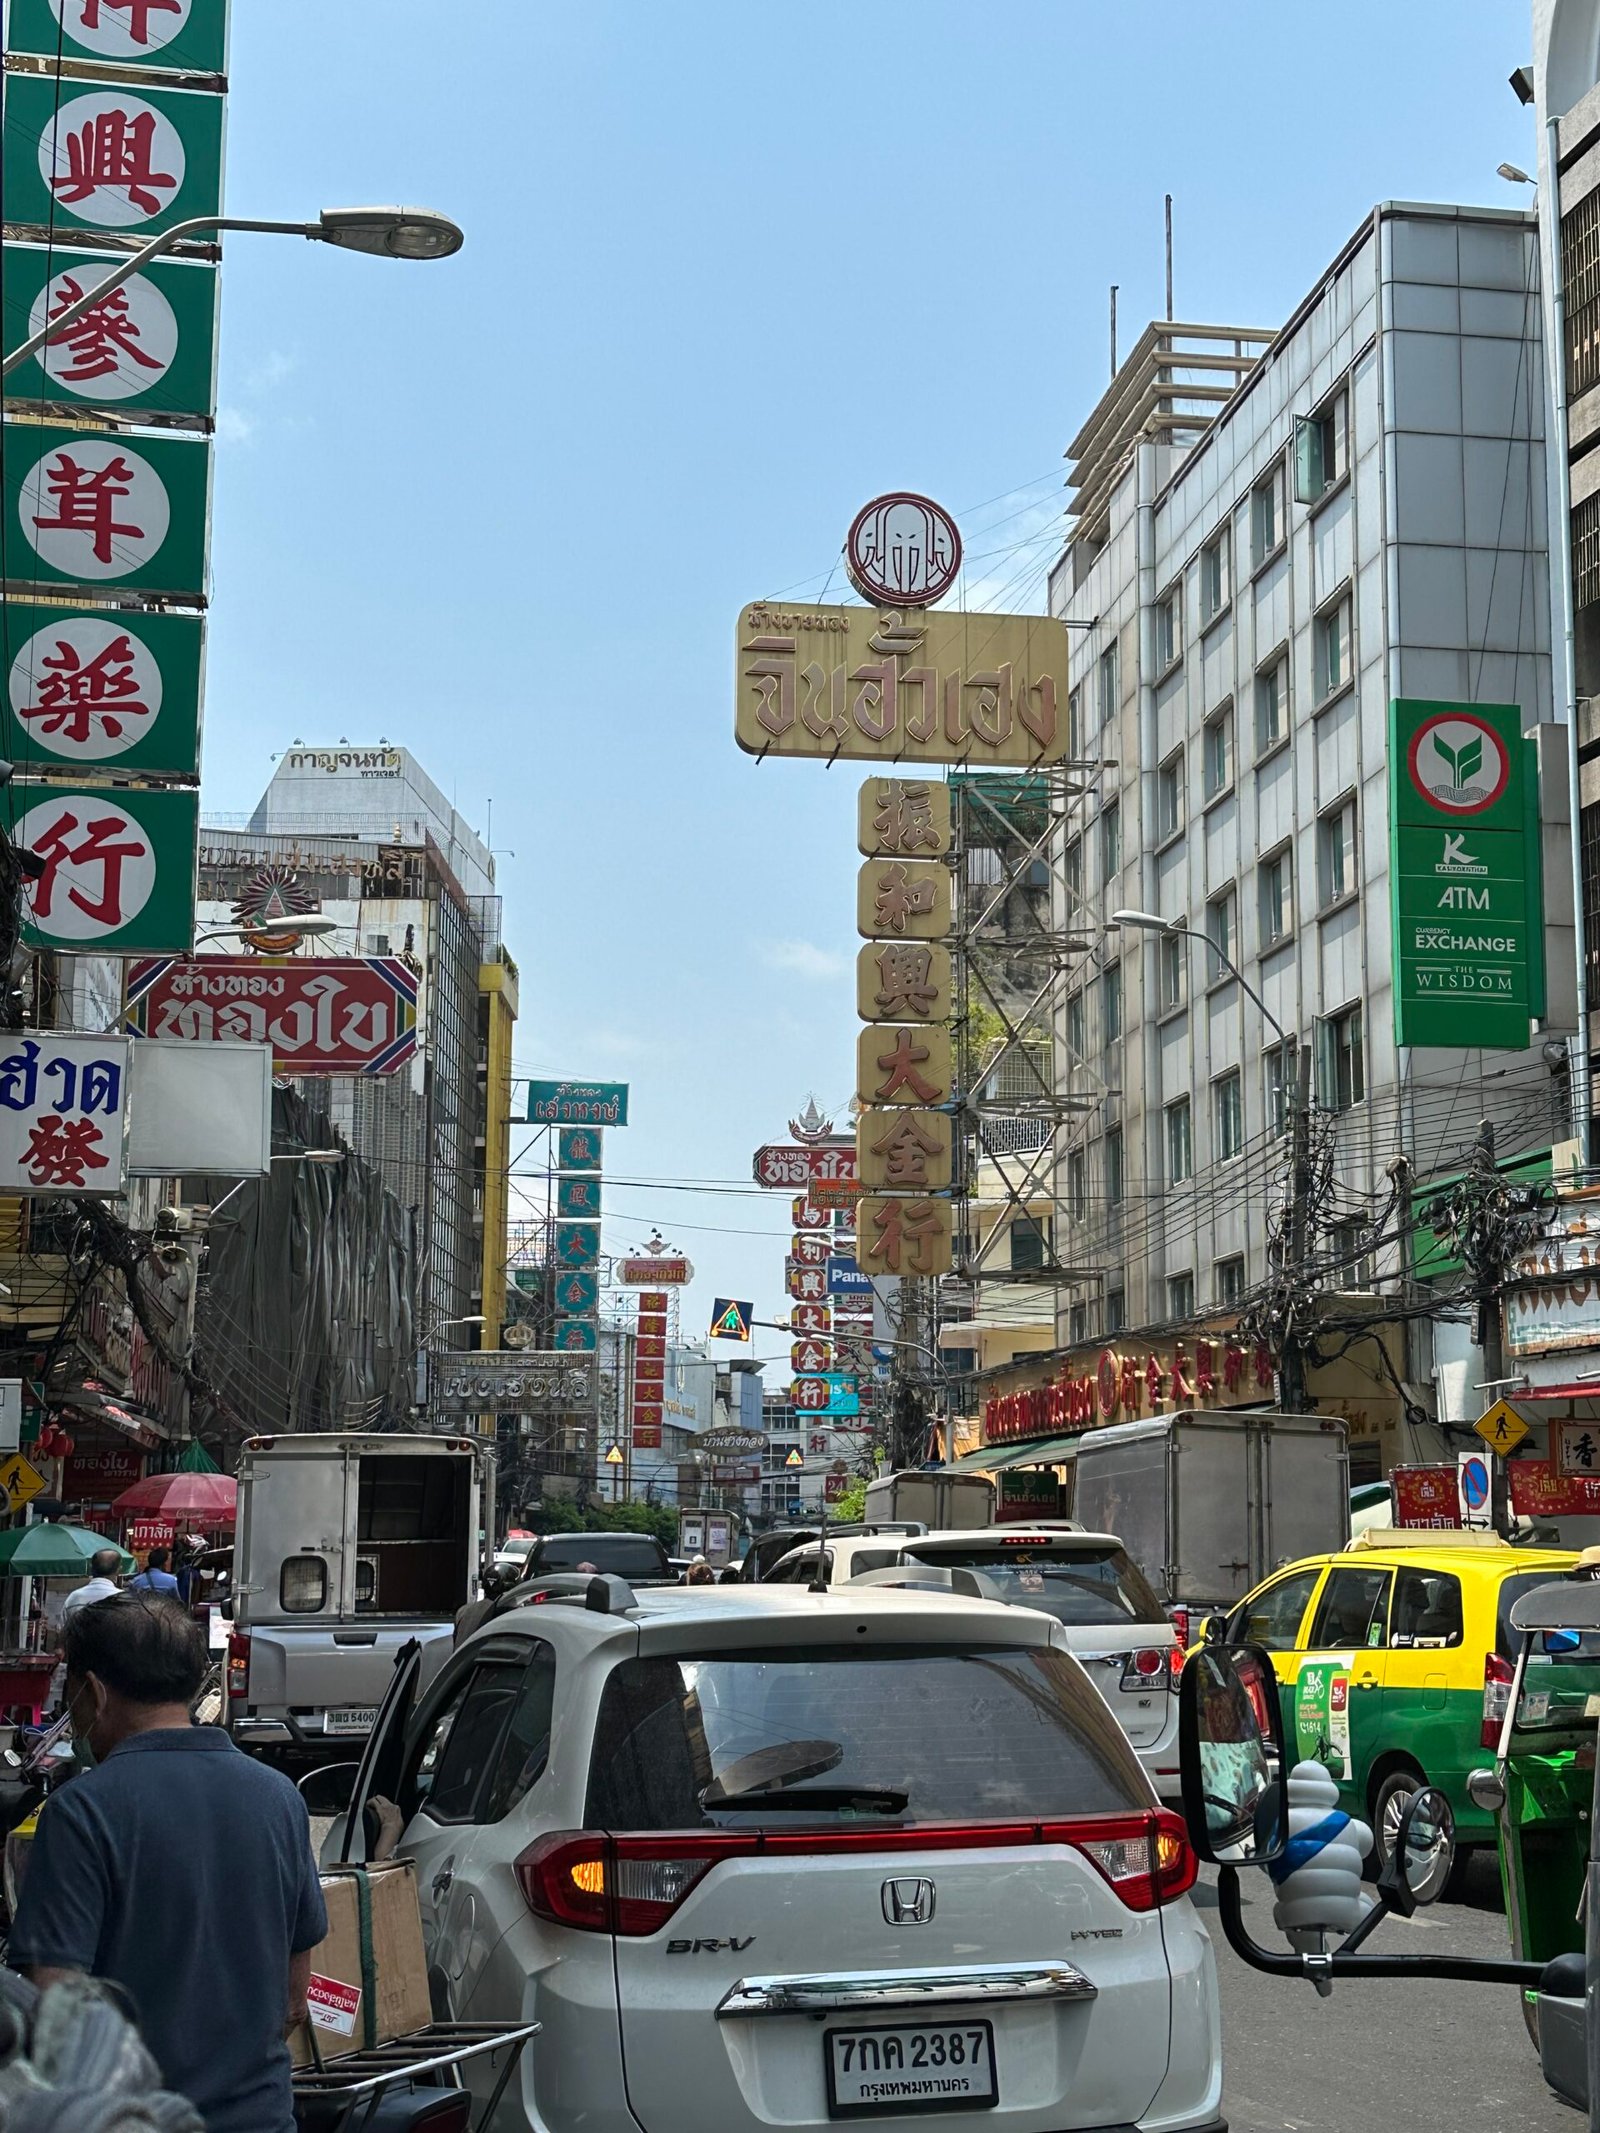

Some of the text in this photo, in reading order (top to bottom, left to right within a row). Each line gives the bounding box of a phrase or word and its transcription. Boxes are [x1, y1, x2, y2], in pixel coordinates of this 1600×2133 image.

[1437, 886, 1490, 910] ATM
[1415, 927, 1451, 935] CURRENCY
[1415, 935, 1516, 952] EXCHANGE
[170, 966, 286, 996] ห้างทอง
[1416, 973, 1512, 990] WISDOM
[1454, 965, 1474, 974] THE
[154, 975, 388, 1053] ทองใบ
[17, 1114, 110, 1188] 發
[1572, 1432, 1598, 1468] 香
[133, 1522, 173, 1540] เกาลัด
[666, 1935, 757, 1954] BR-V
[838, 2031, 984, 2073] 7กค 2387
[859, 2077, 970, 2102] กรุงเทพมหานคร
